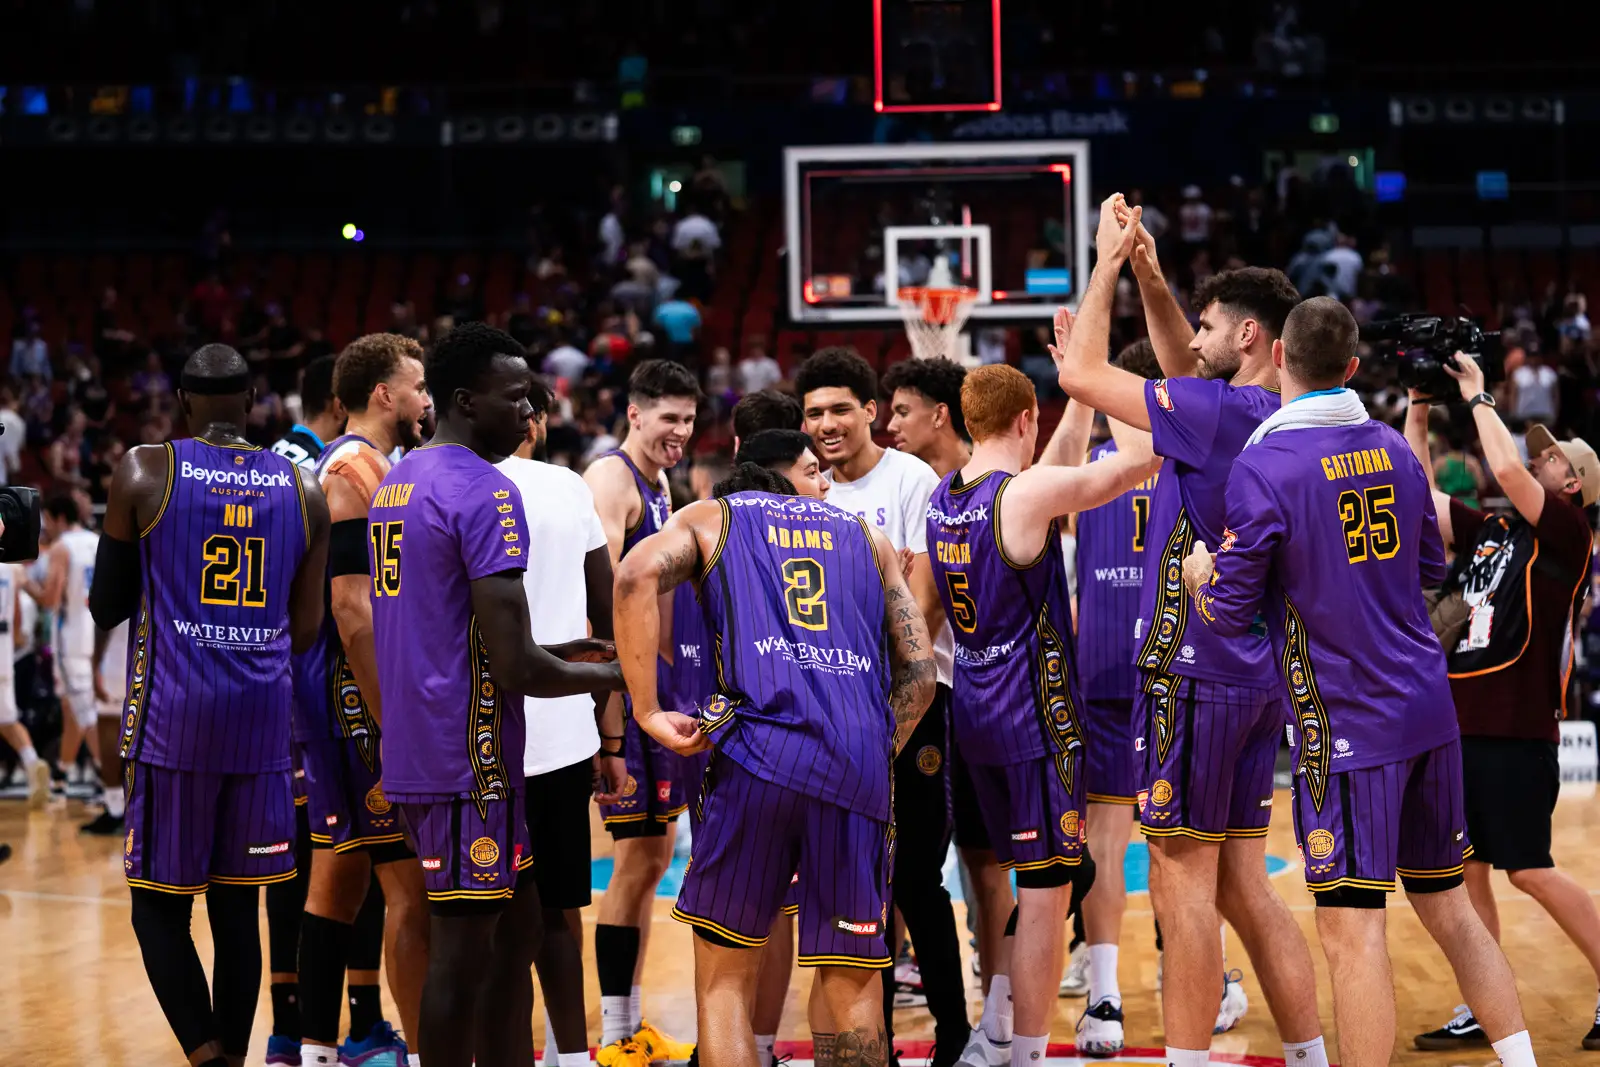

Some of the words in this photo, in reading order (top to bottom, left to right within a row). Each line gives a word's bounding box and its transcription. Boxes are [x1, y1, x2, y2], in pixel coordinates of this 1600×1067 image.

[1051, 107, 1129, 135] Bank
[181, 461, 248, 487] Beyond
[250, 469, 292, 488] Bank
[1320, 447, 1393, 481] GATTORNA
[211, 487, 265, 498] AUSTRALIA
[224, 503, 253, 528] NOI
[730, 497, 807, 513] Beyond
[808, 502, 859, 523] Bank
[766, 510, 830, 522] AUSTRALIA
[767, 524, 834, 551] ADAMS
[1337, 484, 1401, 565] 25
[200, 534, 267, 608] 21
[370, 519, 404, 597] 15
[781, 557, 828, 631] 2
[945, 571, 977, 634] 5
[173, 619, 283, 642] WATERVIEW
[753, 636, 871, 673] WATERVIEW
[248, 842, 289, 854] SHOEGRAB
